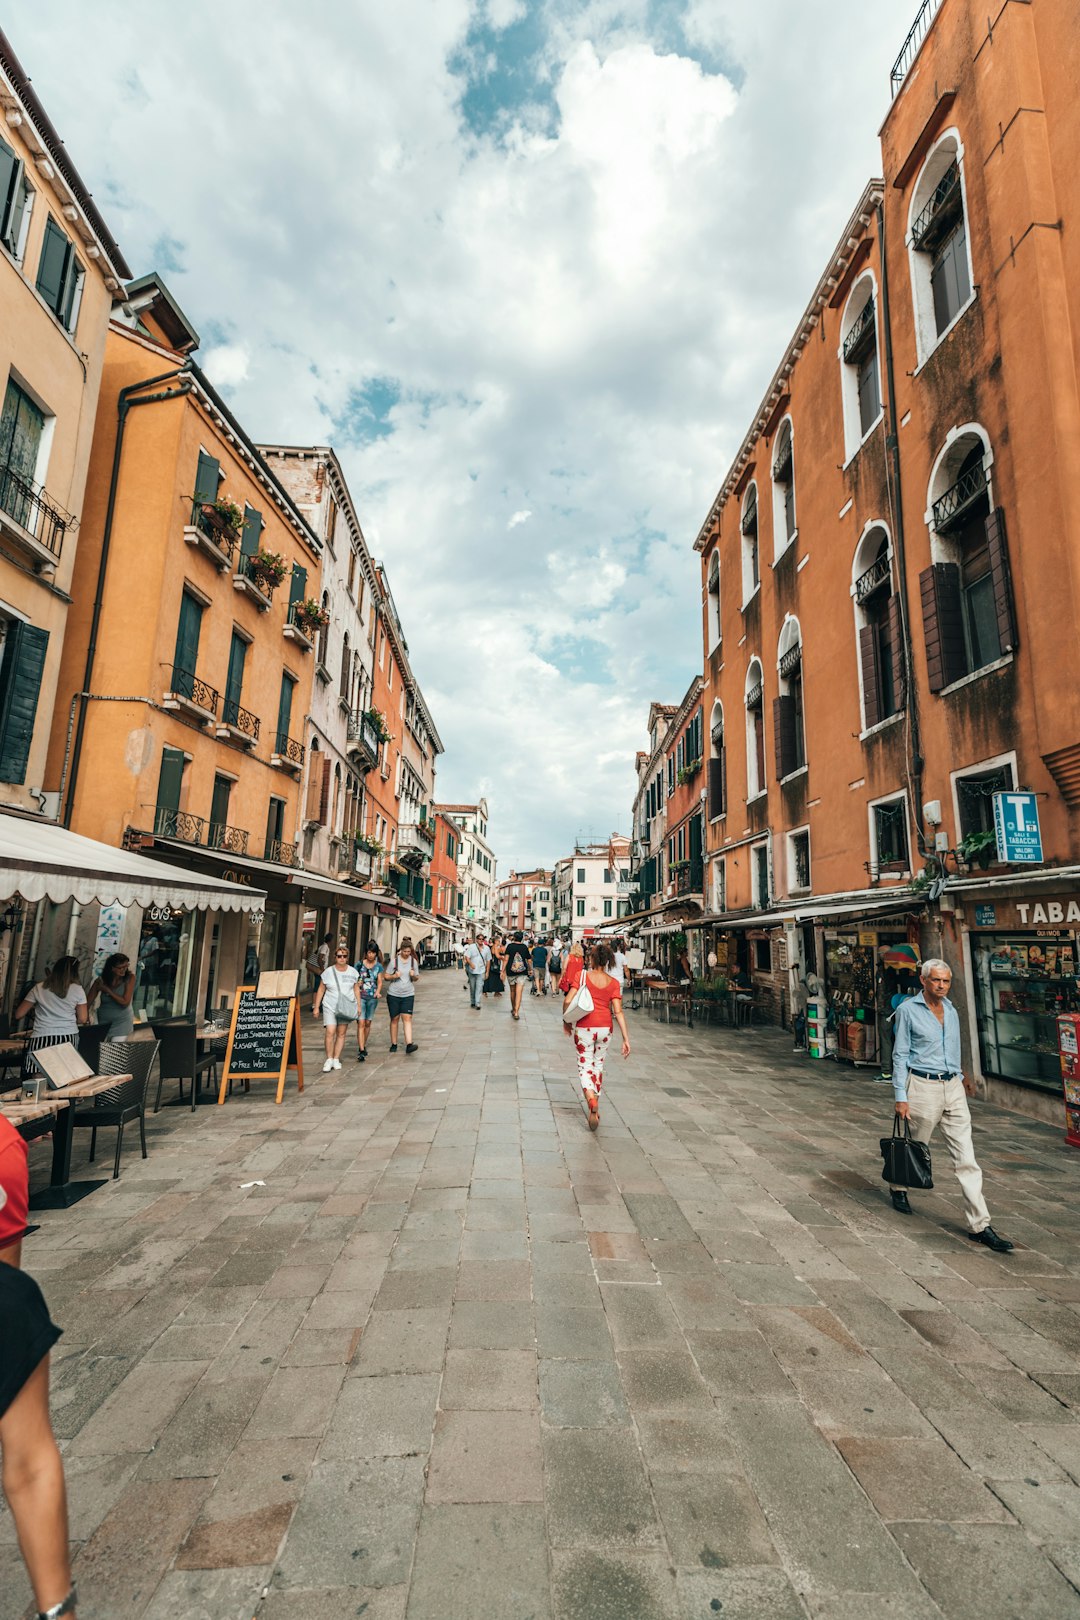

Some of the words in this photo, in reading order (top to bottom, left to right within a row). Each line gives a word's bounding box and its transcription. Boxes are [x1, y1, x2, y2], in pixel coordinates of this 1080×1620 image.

[1007, 796, 1030, 831] T
[994, 796, 1004, 860] TABACCHI
[1016, 901, 1080, 923] TABA
[238, 1060, 251, 1068] FREE
